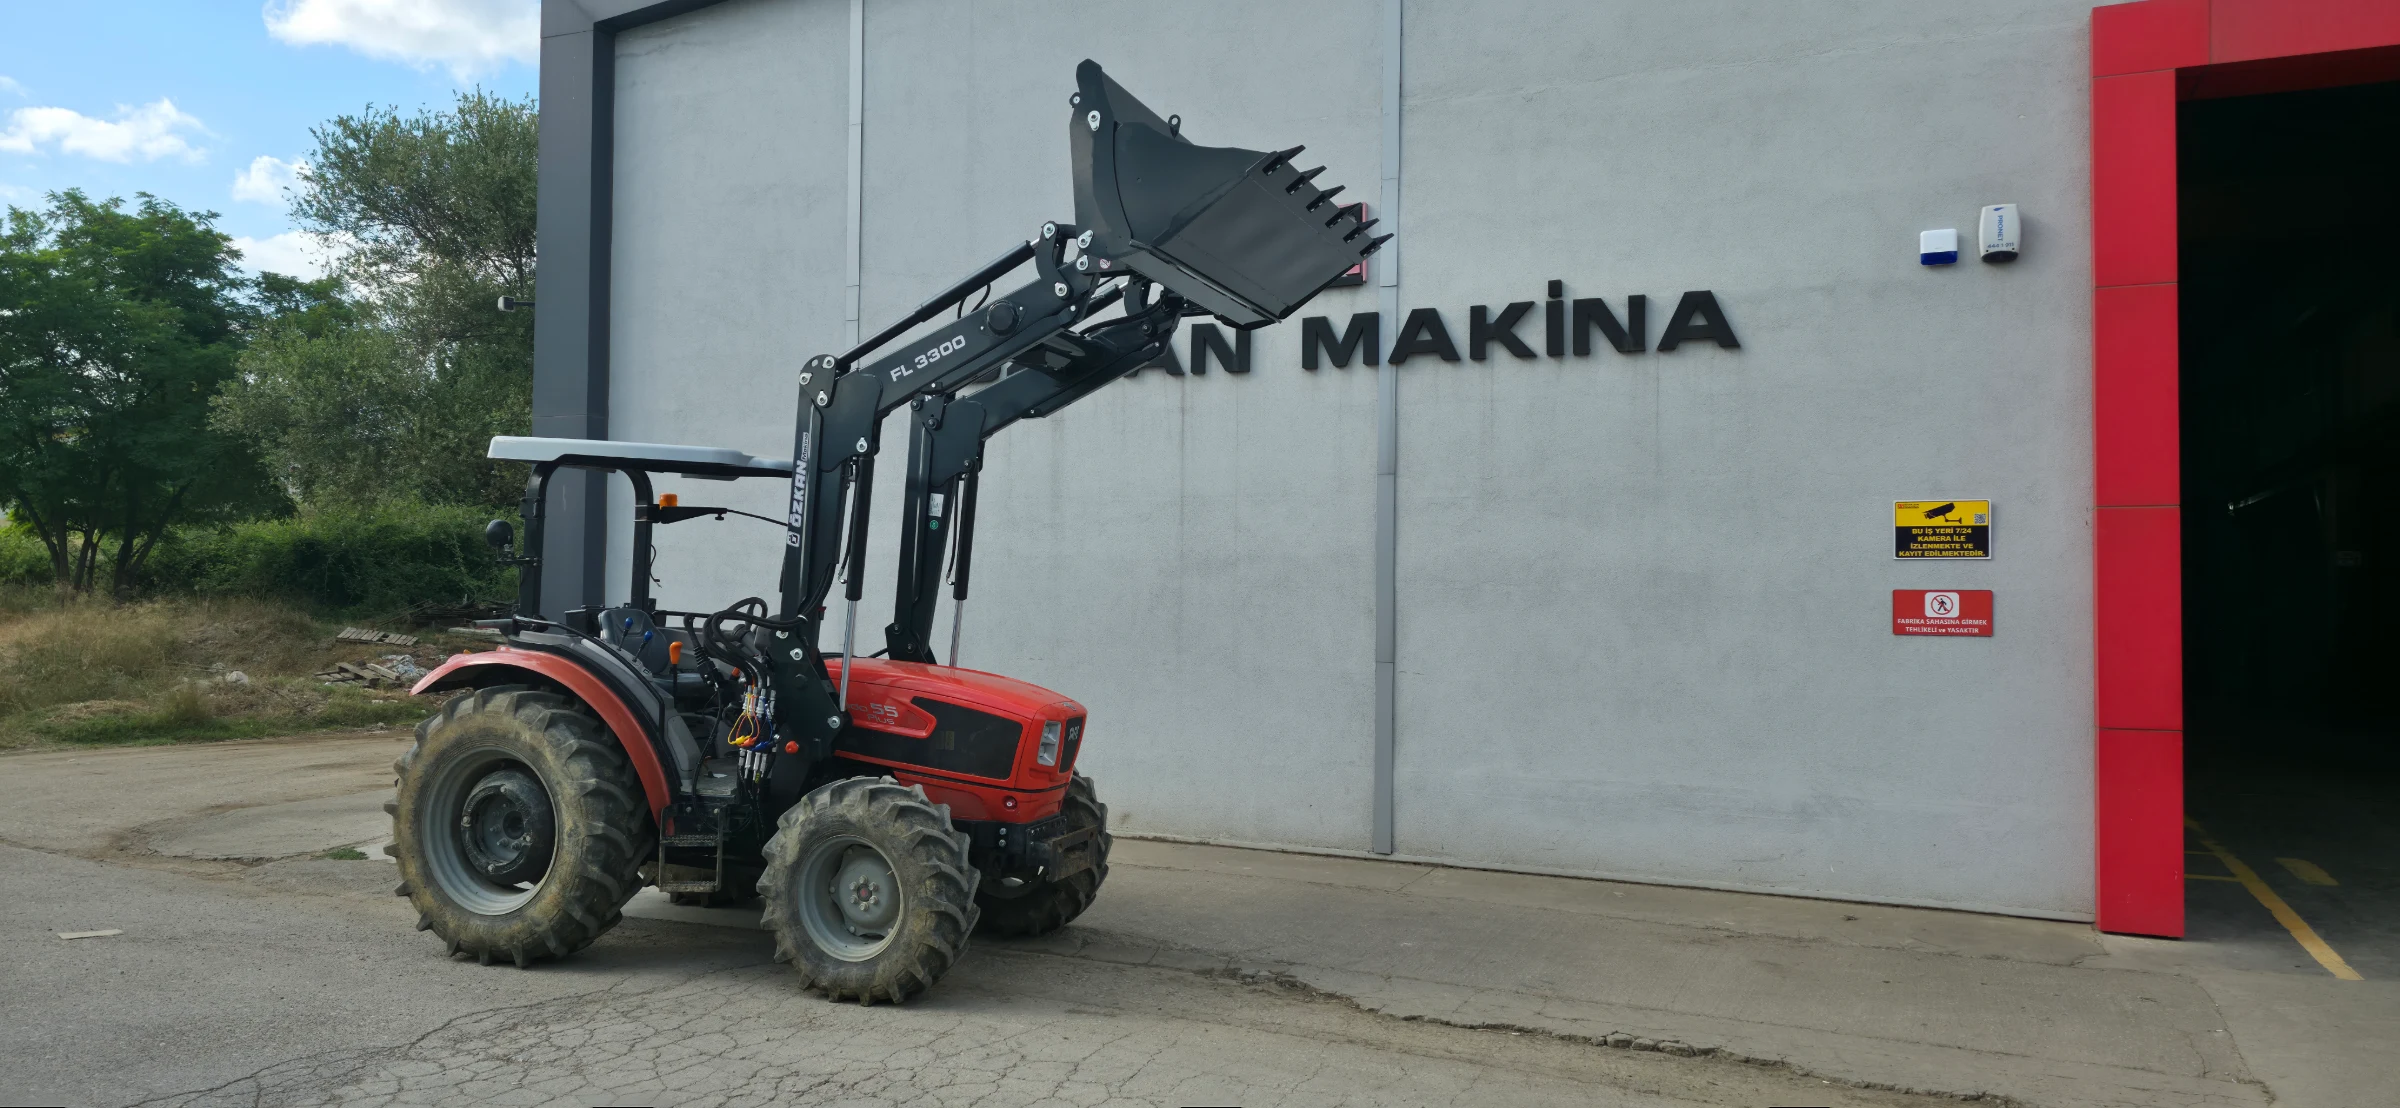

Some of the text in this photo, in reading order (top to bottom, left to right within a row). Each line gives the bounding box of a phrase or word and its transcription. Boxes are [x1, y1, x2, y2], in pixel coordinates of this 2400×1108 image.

[1302, 279, 1740, 370] MAKİNA
[890, 365, 913, 382] FL
[915, 335, 966, 369] 3300
[789, 460, 807, 528] ÖZKAN
[1925, 527, 1933, 535] İŞ
[1924, 549, 1986, 557] EDİLMEKTEDİR.
[870, 702, 899, 718] 55
